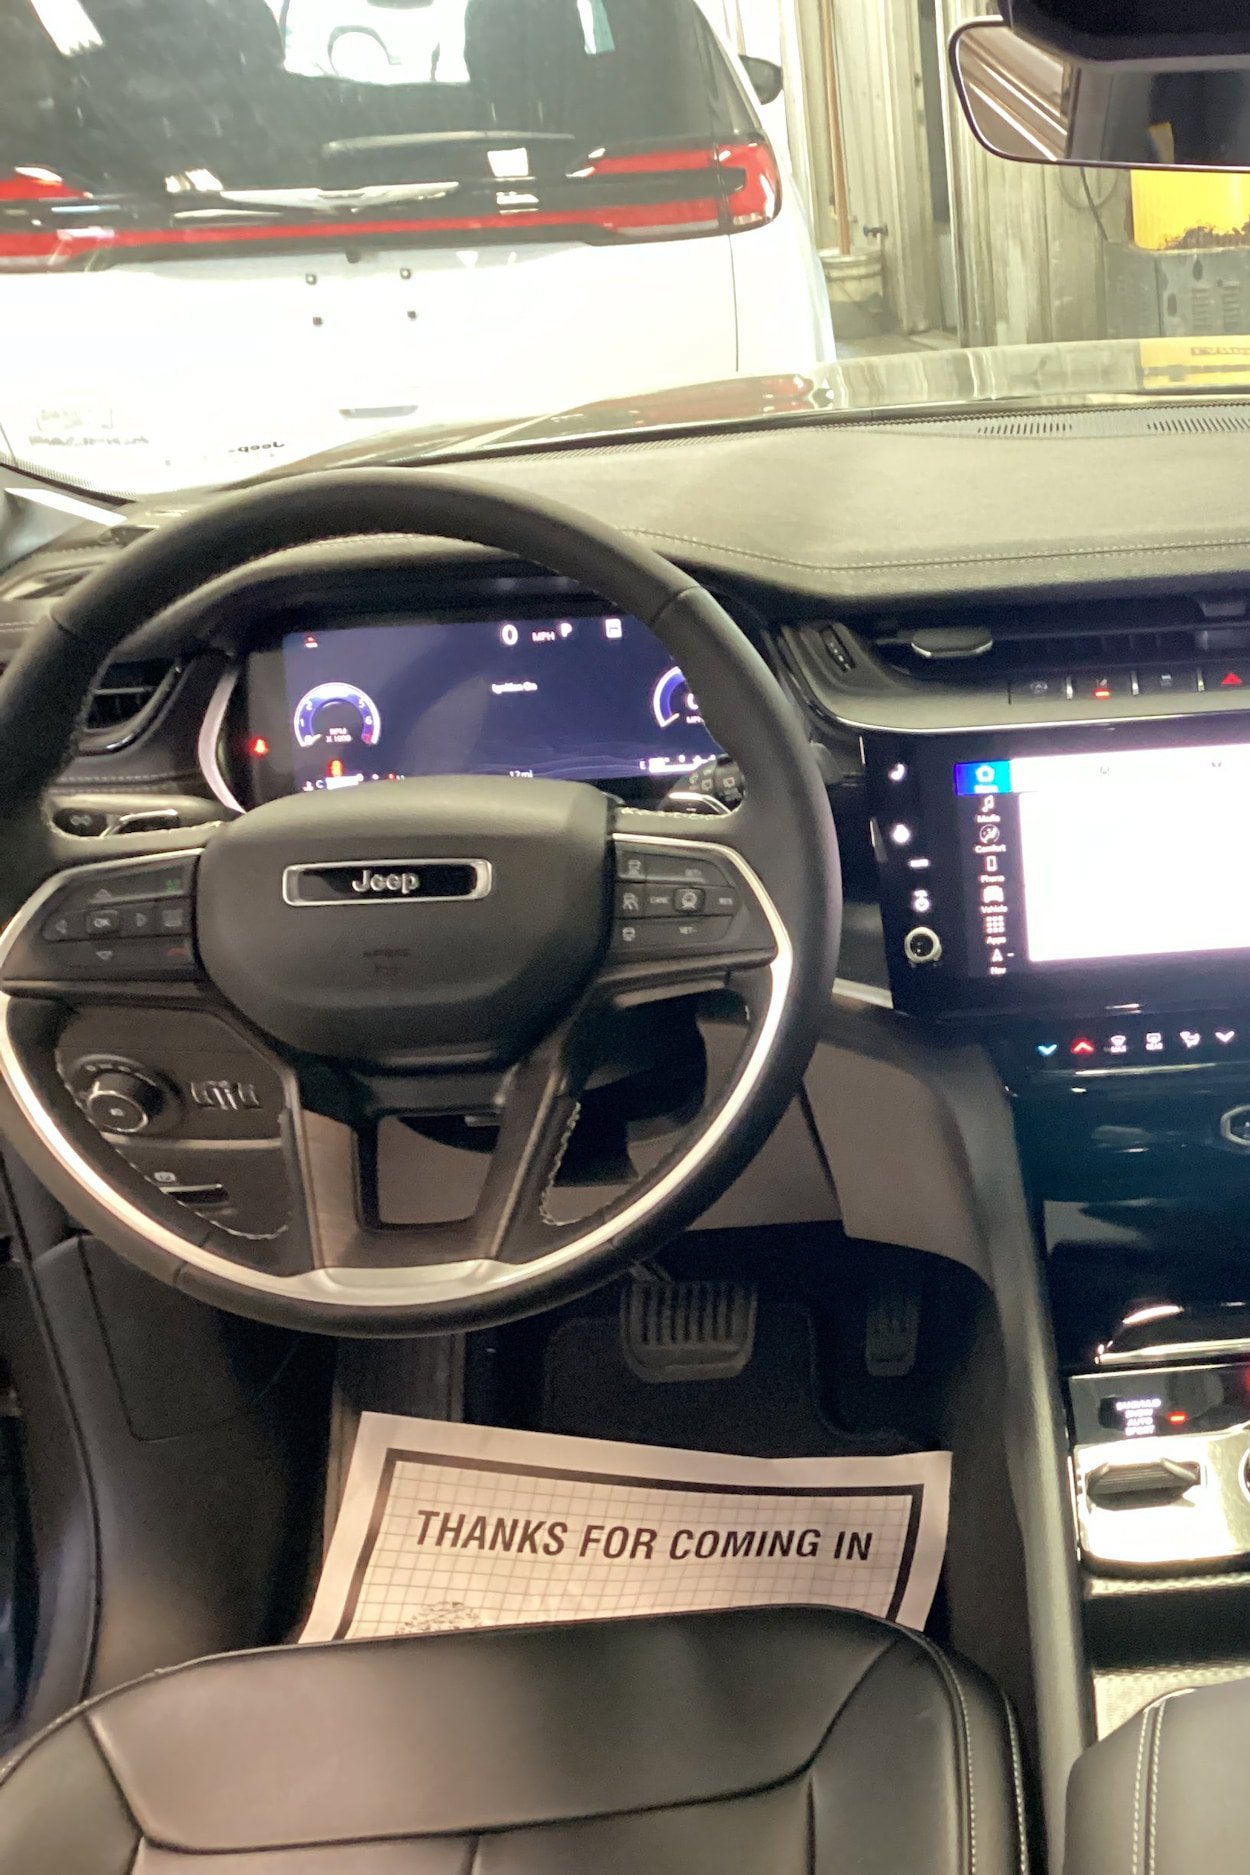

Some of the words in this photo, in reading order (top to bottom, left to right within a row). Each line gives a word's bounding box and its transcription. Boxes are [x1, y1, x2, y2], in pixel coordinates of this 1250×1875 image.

[502, 624, 518, 646] 0
[532, 631, 556, 642] MPH
[560, 622, 573, 638] P
[974, 844, 1007, 853] Comfort
[352, 869, 420, 895] Jeep
[980, 875, 1005, 883] Phone
[980, 905, 1008, 914] Vehicle
[986, 936, 1007, 945] Apps
[990, 967, 1007, 975] Nav
[1126, 1416, 1153, 1427] AUTO
[416, 1510, 568, 1556] THANKS
[579, 1525, 657, 1560] FOR
[669, 1528, 822, 1560] COMING
[834, 1531, 872, 1561] IN
